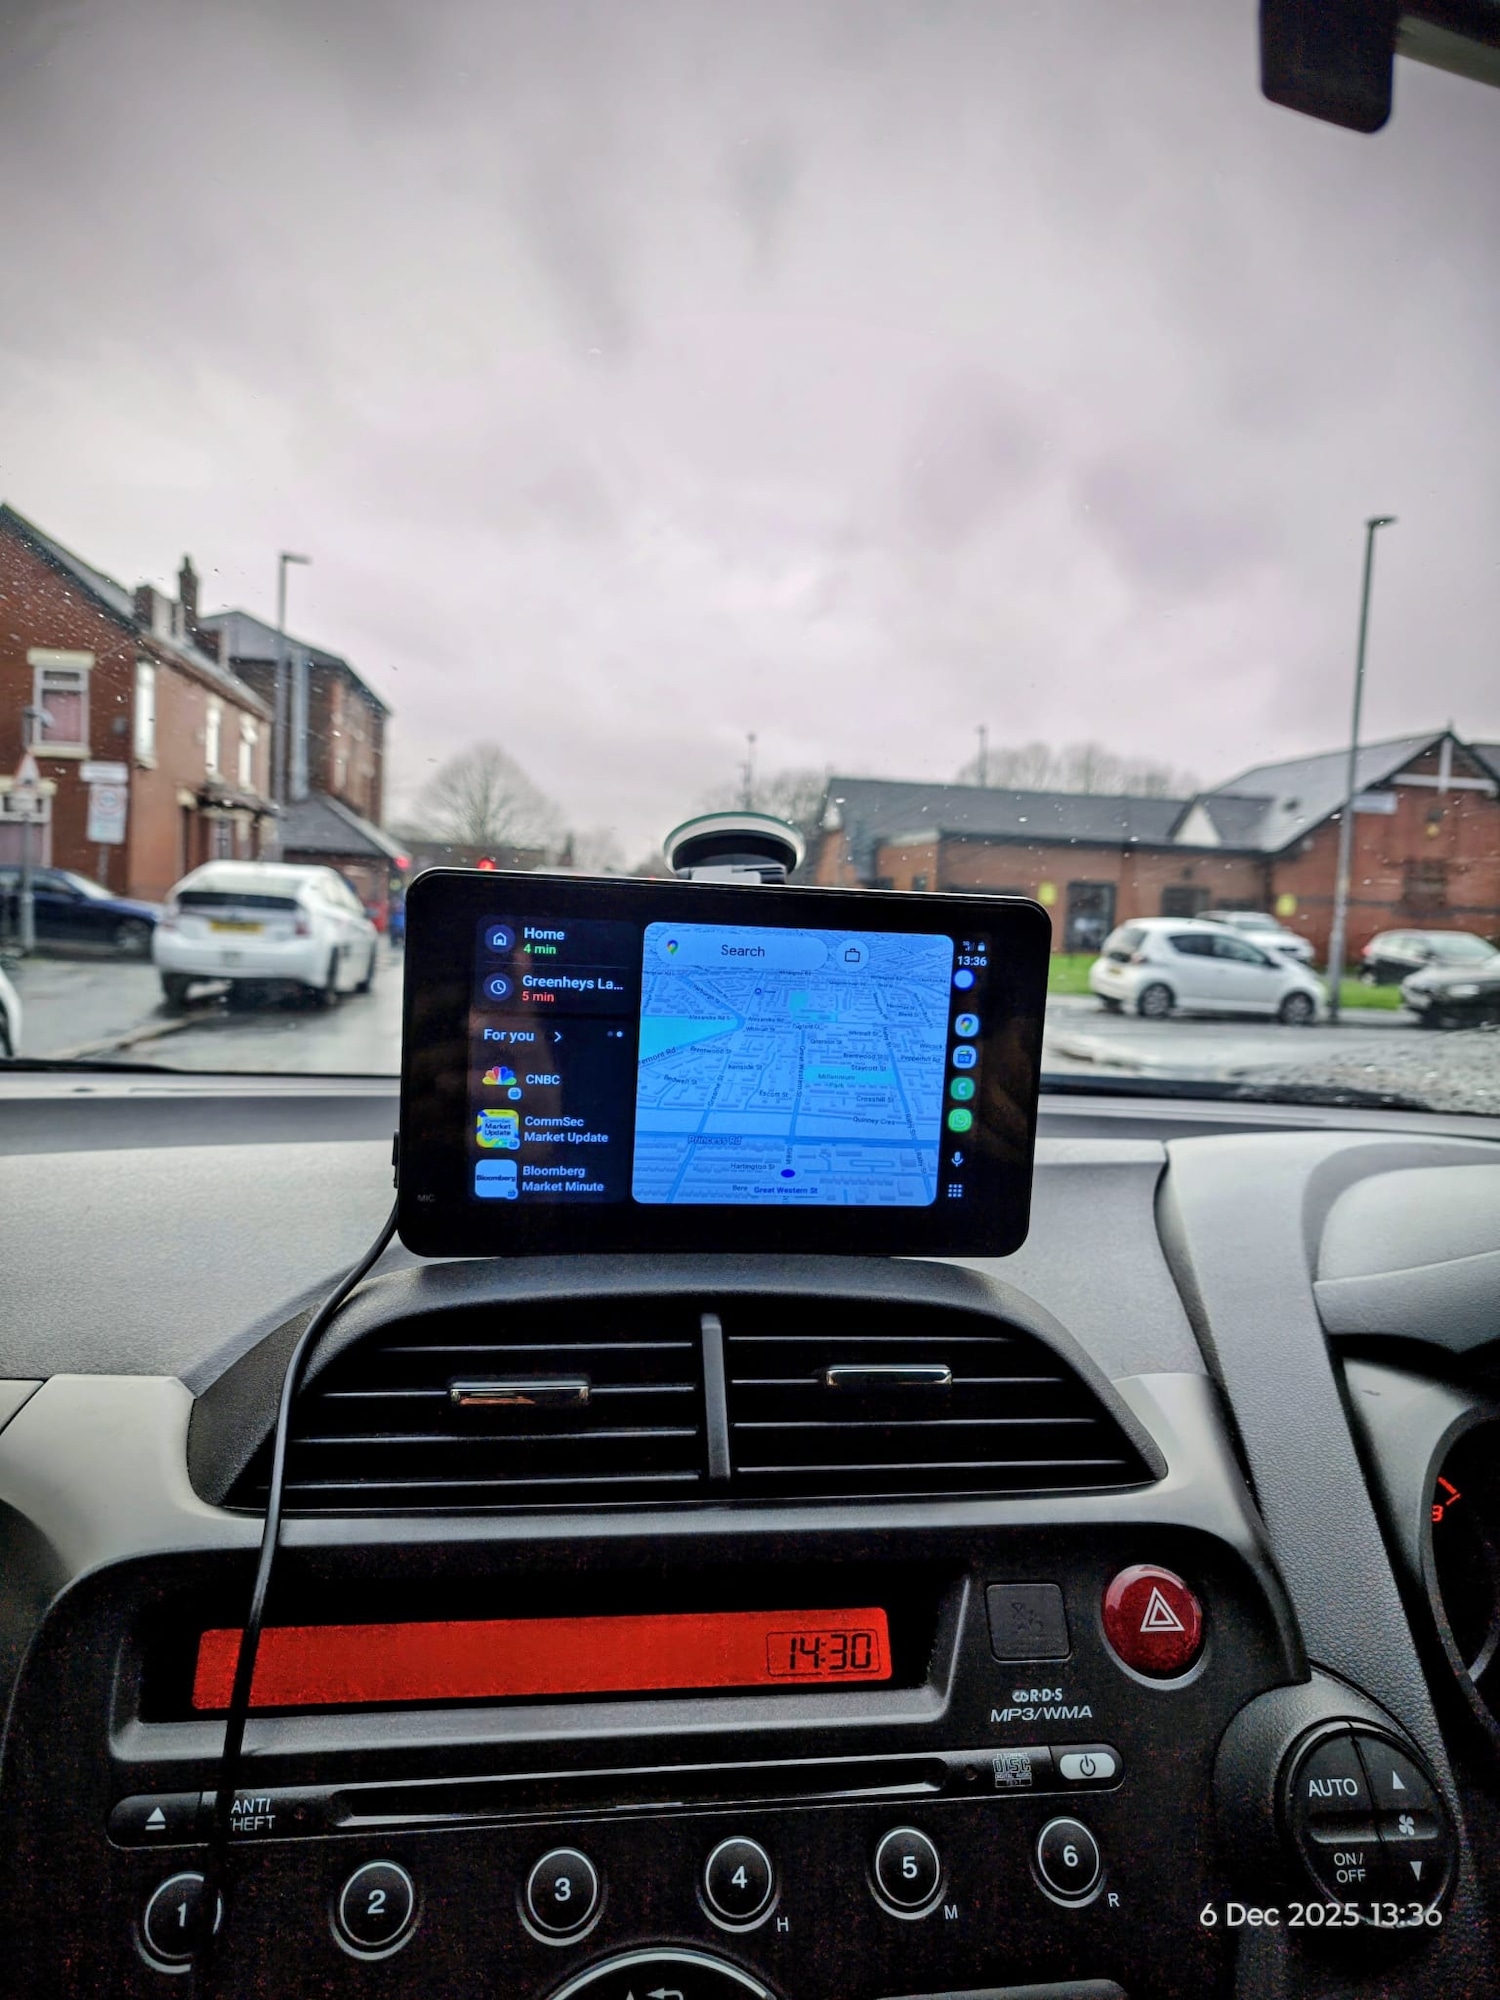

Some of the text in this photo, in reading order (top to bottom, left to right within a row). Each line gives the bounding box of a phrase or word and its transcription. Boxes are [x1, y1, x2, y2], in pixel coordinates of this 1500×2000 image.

[524, 927, 565, 940] Home
[524, 944, 556, 954] 4 min
[721, 944, 766, 957] Search
[957, 956, 987, 966] 13:36
[522, 974, 594, 992] Greenheys
[522, 990, 554, 1002] 5 min
[484, 1028, 534, 1044] For you
[665, 1046, 676, 1055] Rd
[526, 1074, 560, 1085] CNBC
[524, 1116, 584, 1127] CommSec
[524, 1132, 608, 1144] Market Update
[729, 1136, 742, 1145] Rd
[522, 1166, 586, 1178] Bloomberg
[522, 1182, 604, 1192] Market Minute
[417, 1194, 434, 1202] MIC
[790, 1632, 872, 1670] 14:30
[990, 1705, 1093, 1722] MP3/WMA
[992, 1756, 1032, 1773] DISC
[1308, 1778, 1358, 1798] AUTO
[231, 1798, 271, 1814] ANTI
[230, 1814, 276, 1831] HEFT
[1062, 1845, 1078, 1868] 6
[902, 1856, 918, 1879] 5
[732, 1866, 748, 1889] 4
[1336, 1869, 1366, 1884] OFF
[554, 1877, 572, 1901] 3
[367, 1890, 386, 1914] 2
[1107, 1892, 1120, 1908] R
[177, 1902, 187, 1928] 1
[944, 1904, 958, 1920] M
[776, 1916, 790, 1932] H
